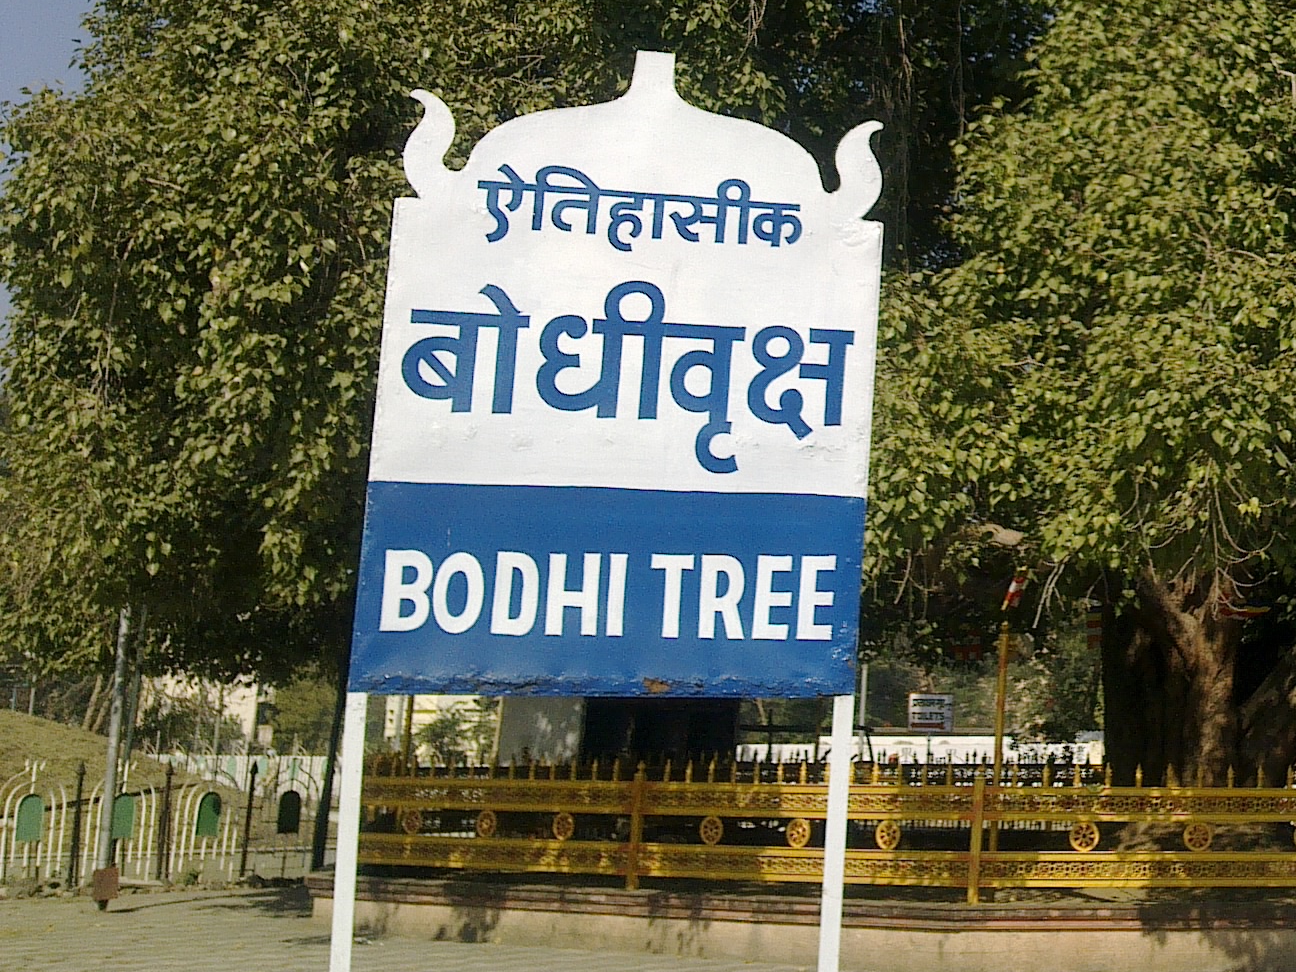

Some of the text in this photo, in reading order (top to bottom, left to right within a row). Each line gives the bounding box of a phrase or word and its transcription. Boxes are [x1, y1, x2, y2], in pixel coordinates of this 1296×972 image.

[477, 163, 803, 252] ऐतिहासीक
[401, 280, 855, 474] बोधीवृक्ष
[378, 549, 837, 641] BODHI TREE
